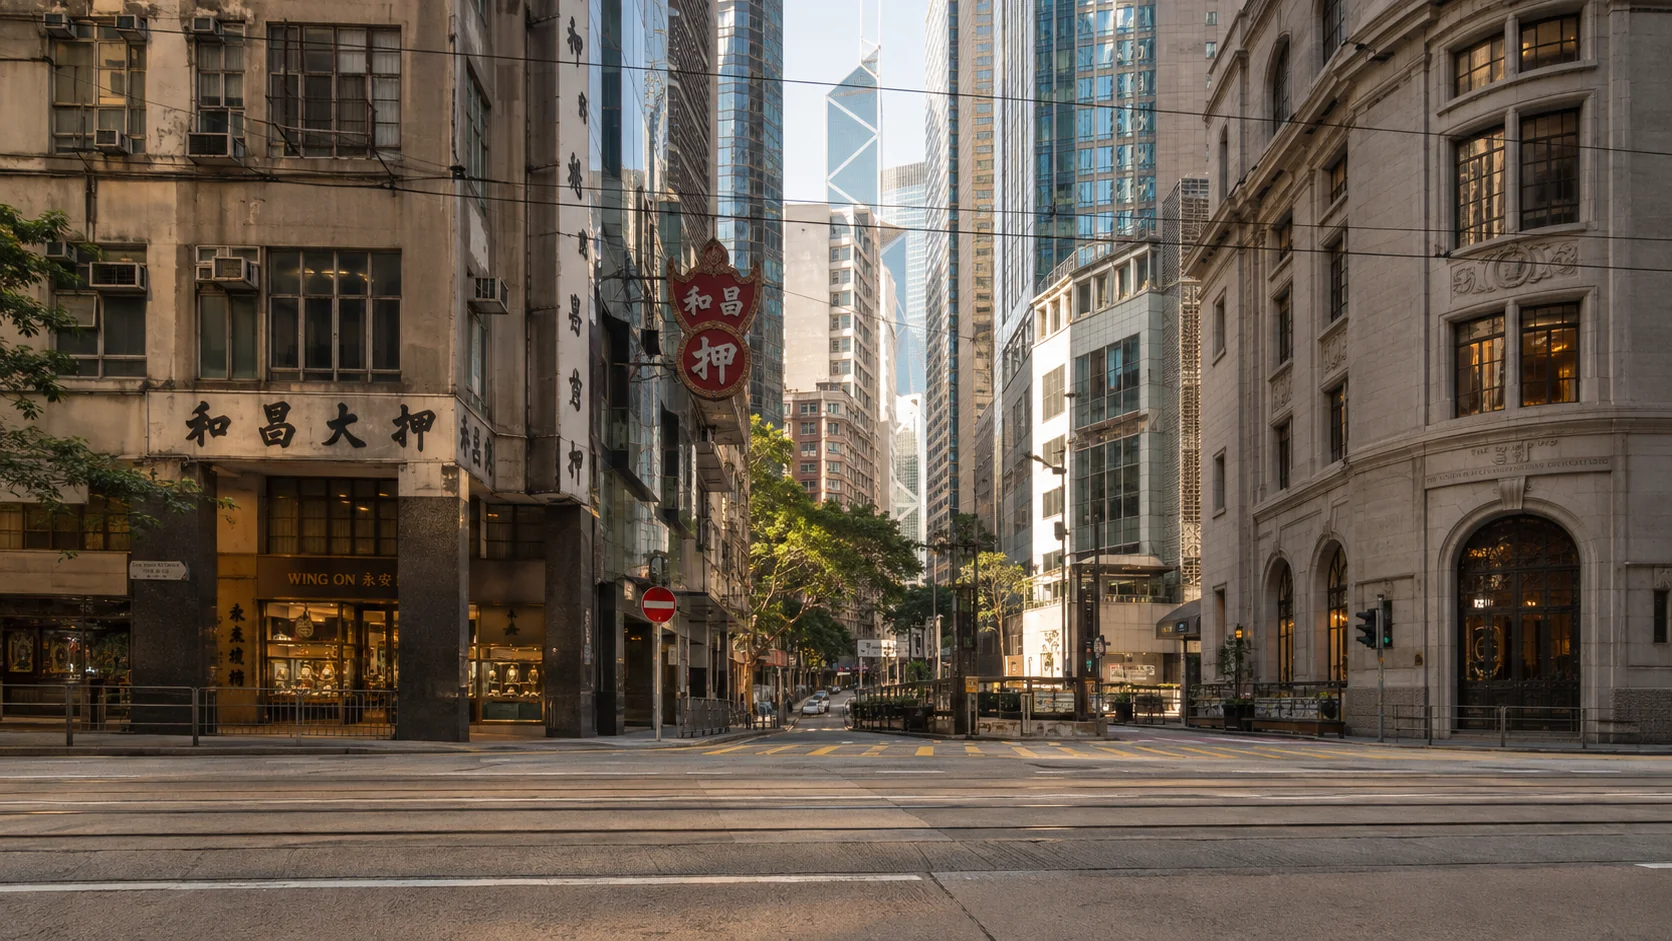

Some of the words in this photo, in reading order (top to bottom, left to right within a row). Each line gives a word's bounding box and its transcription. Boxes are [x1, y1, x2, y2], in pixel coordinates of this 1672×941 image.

[683, 285, 744, 317] 和昌
[691, 336, 738, 385] 押
[185, 400, 437, 452] 和昌大押
[287, 572, 329, 585] WING
[333, 573, 356, 585] ON
